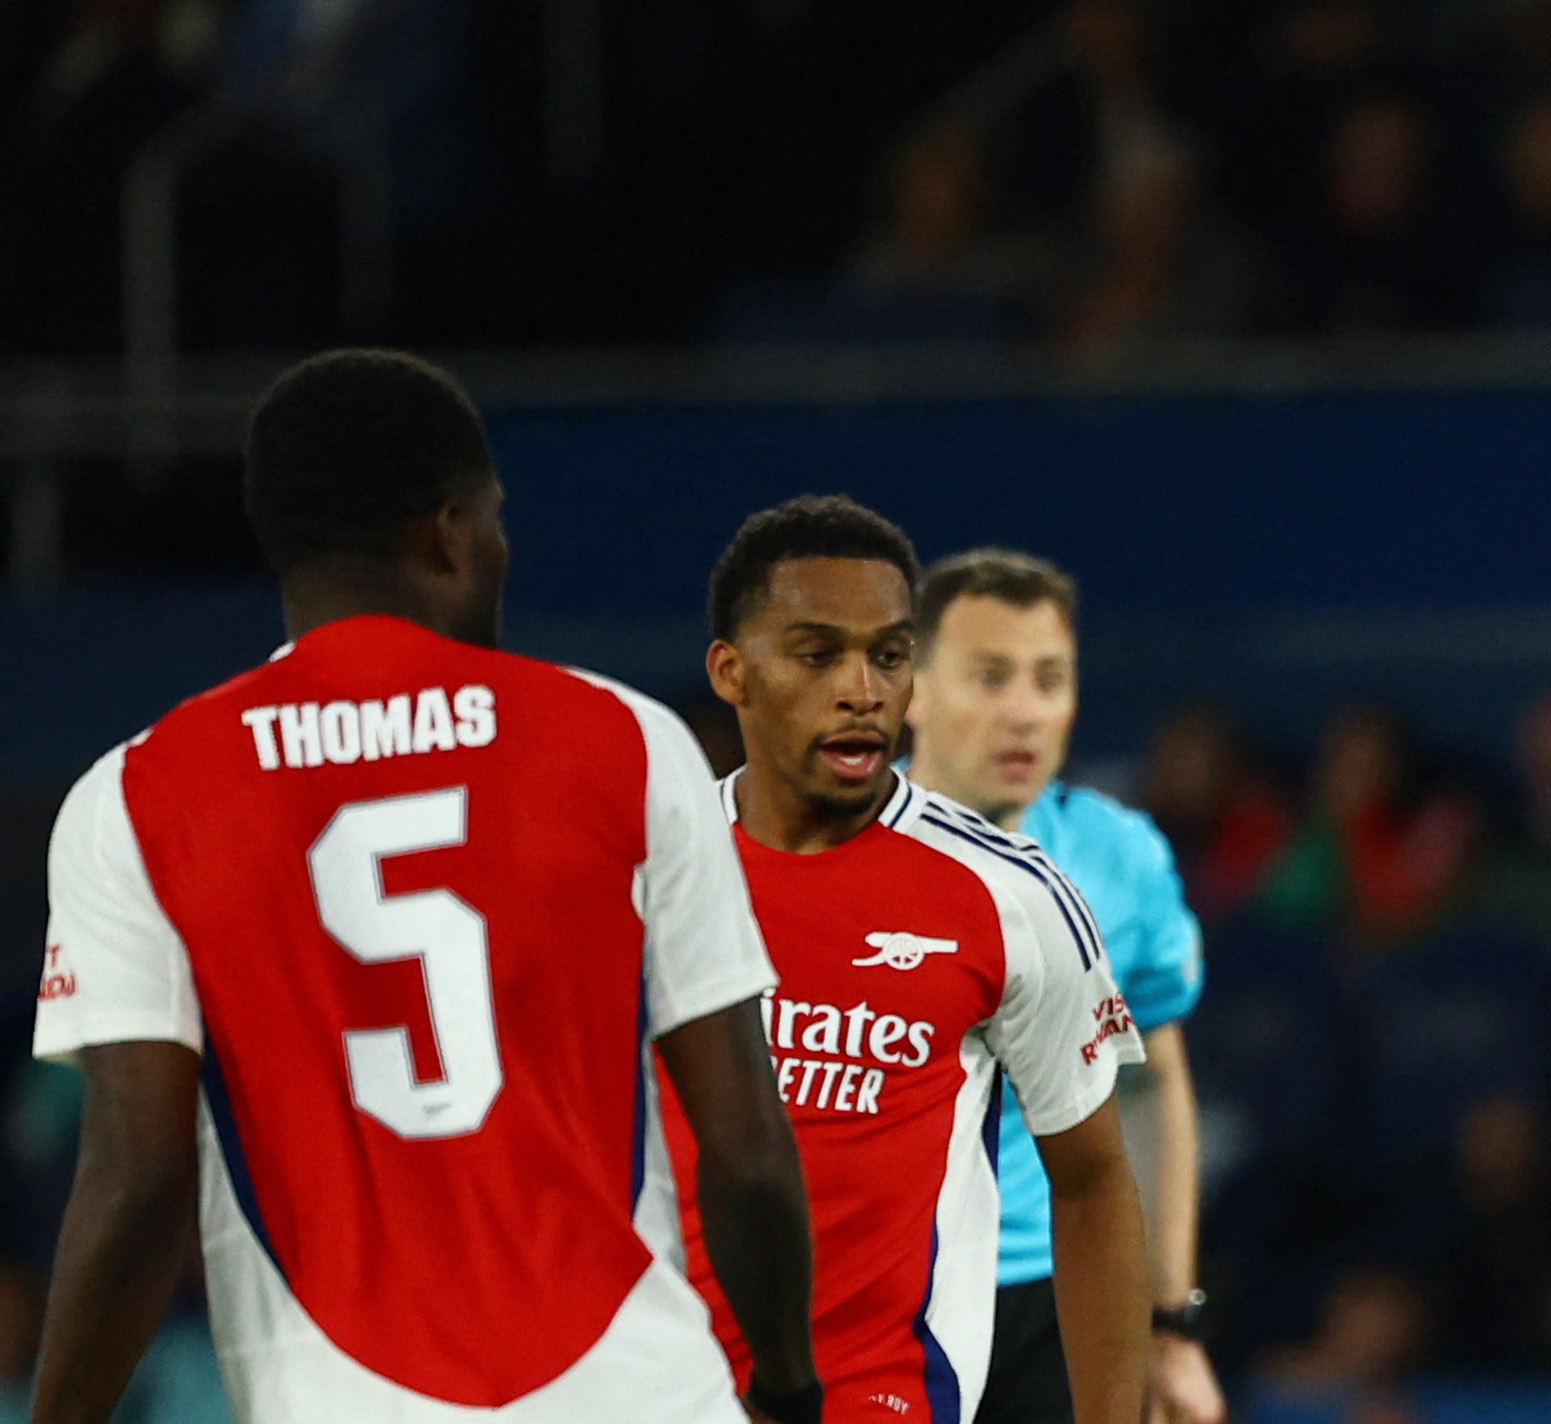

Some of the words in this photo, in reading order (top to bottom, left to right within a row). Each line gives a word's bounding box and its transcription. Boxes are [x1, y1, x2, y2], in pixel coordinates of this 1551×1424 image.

[241, 684, 498, 771] THOMAS
[306, 786, 503, 1140] 5
[760, 987, 935, 1068] irates
[1092, 991, 1127, 1021] VIS
[771, 1056, 885, 1115] ETTER
